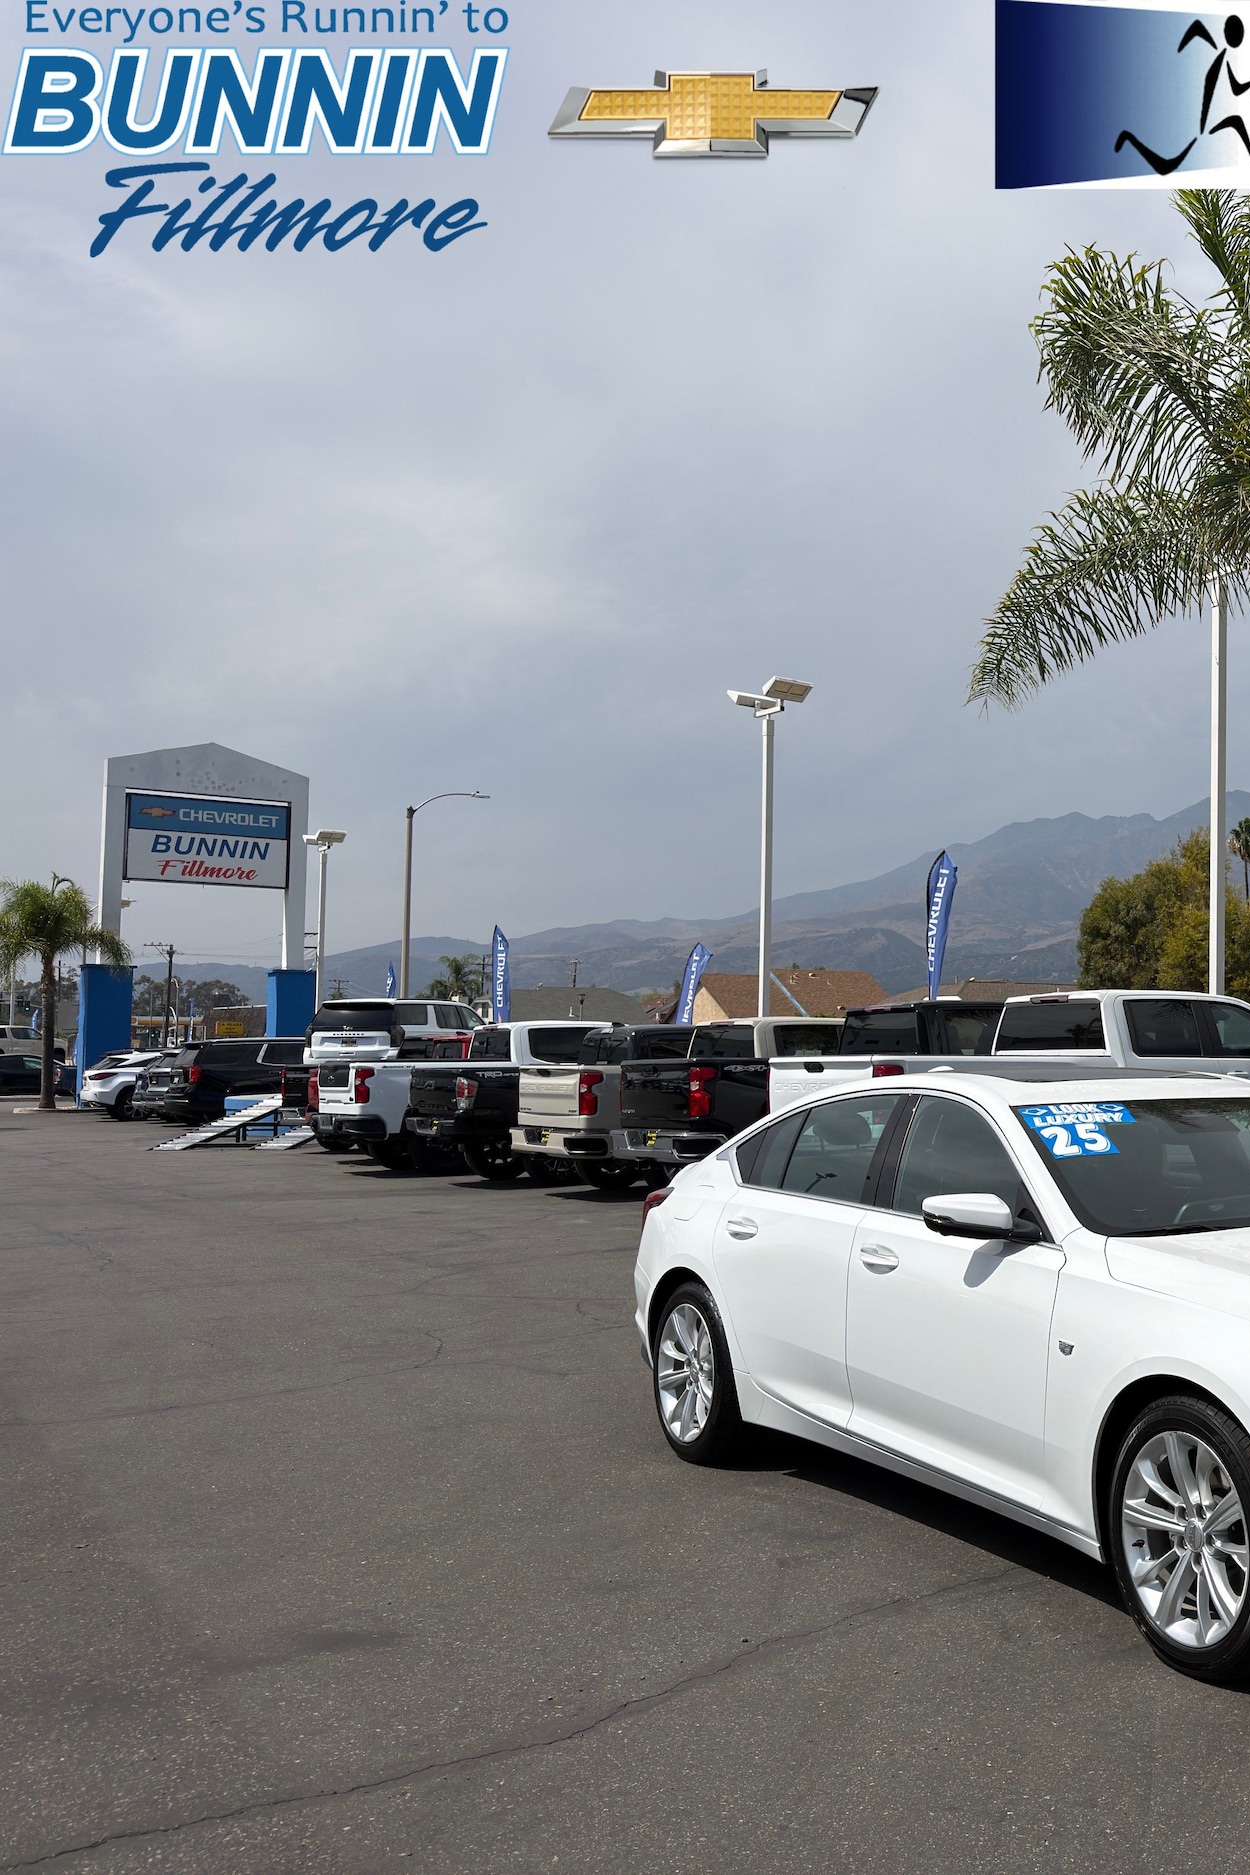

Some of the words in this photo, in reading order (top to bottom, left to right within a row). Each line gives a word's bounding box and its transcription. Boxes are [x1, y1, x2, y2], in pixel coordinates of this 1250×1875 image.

[179, 808, 279, 828] CHEVROLET
[151, 834, 271, 860] BUNNIN
[156, 859, 259, 881] Fillmore
[773, 1082, 834, 1094] CHEVR
[1048, 1103, 1103, 1114] LOOK
[1033, 1112, 1123, 1127] LUXURY
[1040, 1123, 1112, 1156] 25
